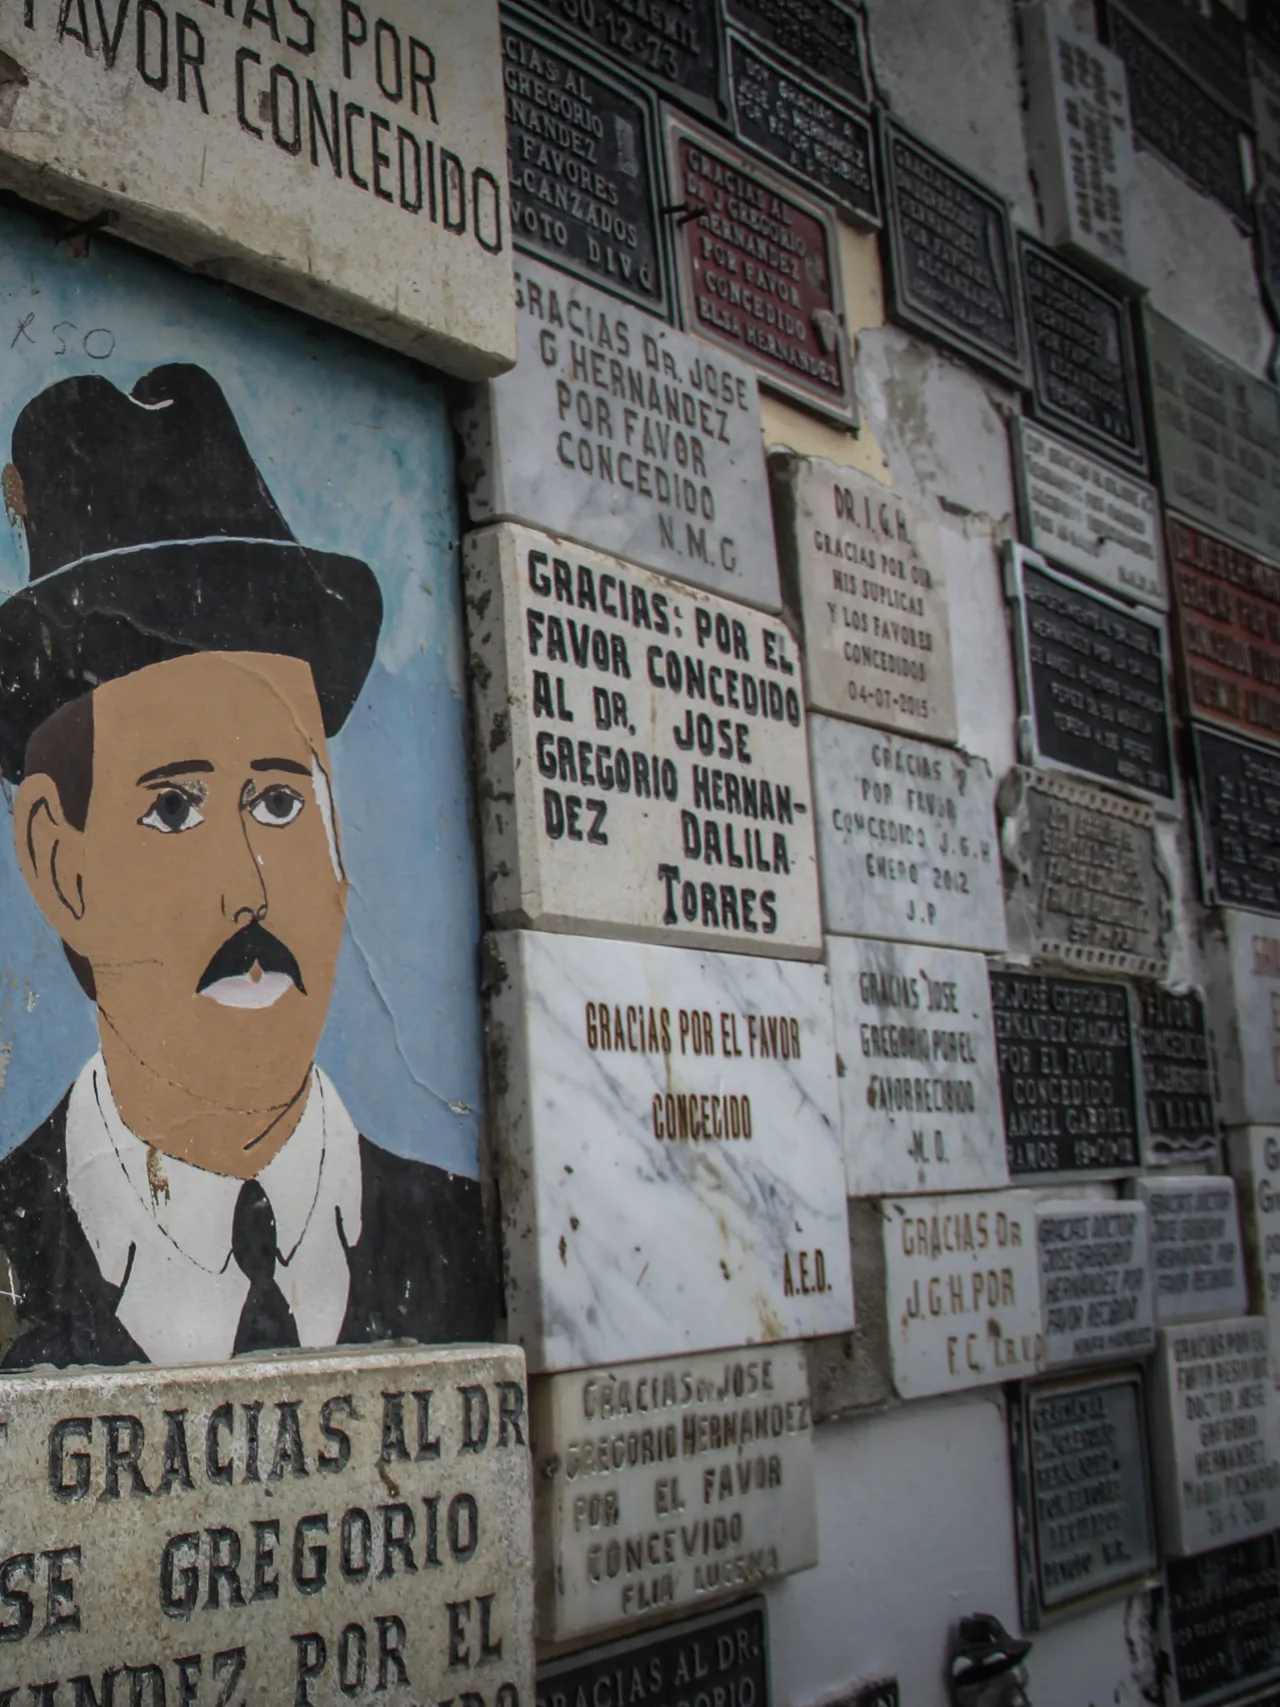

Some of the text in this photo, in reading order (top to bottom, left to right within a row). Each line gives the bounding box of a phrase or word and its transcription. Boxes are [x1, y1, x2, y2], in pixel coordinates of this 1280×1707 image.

[339, 0, 440, 125] POR
[505, 36, 593, 106] CIAS AL
[504, 68, 604, 138] GREGORIO
[506, 99, 598, 165] NANDEZ
[235, 45, 503, 256] CONCEDIDO
[522, 134, 619, 206] FAVORES
[508, 160, 638, 248] LCANZADOS
[700, 236, 803, 310] POR FAVOR
[704, 270, 807, 341] CONCEDIDO
[570, 339, 731, 446] HERNANDEZ
[689, 357, 749, 412] JOSE
[555, 378, 708, 480] POR FAVOR
[556, 430, 716, 523] CONCEDIDO
[812, 529, 877, 571] GRACIAS
[880, 552, 907, 582] POR
[825, 600, 934, 653] Y LOS FAVORES
[831, 568, 925, 618] MIS SUPLICAS
[525, 607, 803, 729] FAVOR CONCEDIDO
[693, 605, 751, 663] POR
[761, 626, 796, 677] EL
[842, 639, 927, 683] CONCEDIDOS
[531, 669, 753, 765] AL DR. JOSE
[535, 729, 680, 802] GREGORIO
[543, 787, 609, 846] DEZ
[680, 808, 792, 876] DALILA
[657, 862, 779, 935] TORRES
[677, 1007, 715, 1057] POR
[718, 1010, 744, 1059] EL
[747, 1014, 802, 1061] FAVOR
[900, 1210, 990, 1259] GRACIAS
[972, 1267, 1016, 1313] POR
[581, 1370, 693, 1423] GRACIAS
[717, 1358, 775, 1404] JOSE
[47, 1393, 353, 1503] GRACIAS
[378, 1389, 442, 1468] AL
[456, 1380, 529, 1457] DR
[564, 1400, 810, 1483] GREGORIO HERNANDEZ
[573, 1453, 783, 1532] POR EL FAVOR
[158, 1491, 480, 1620] GREGORIO
[290, 1614, 411, 1707] POR
[446, 1591, 503, 1669] EL
[542, 1655, 663, 1707] ACIAS
[672, 1640, 710, 1689] AL
